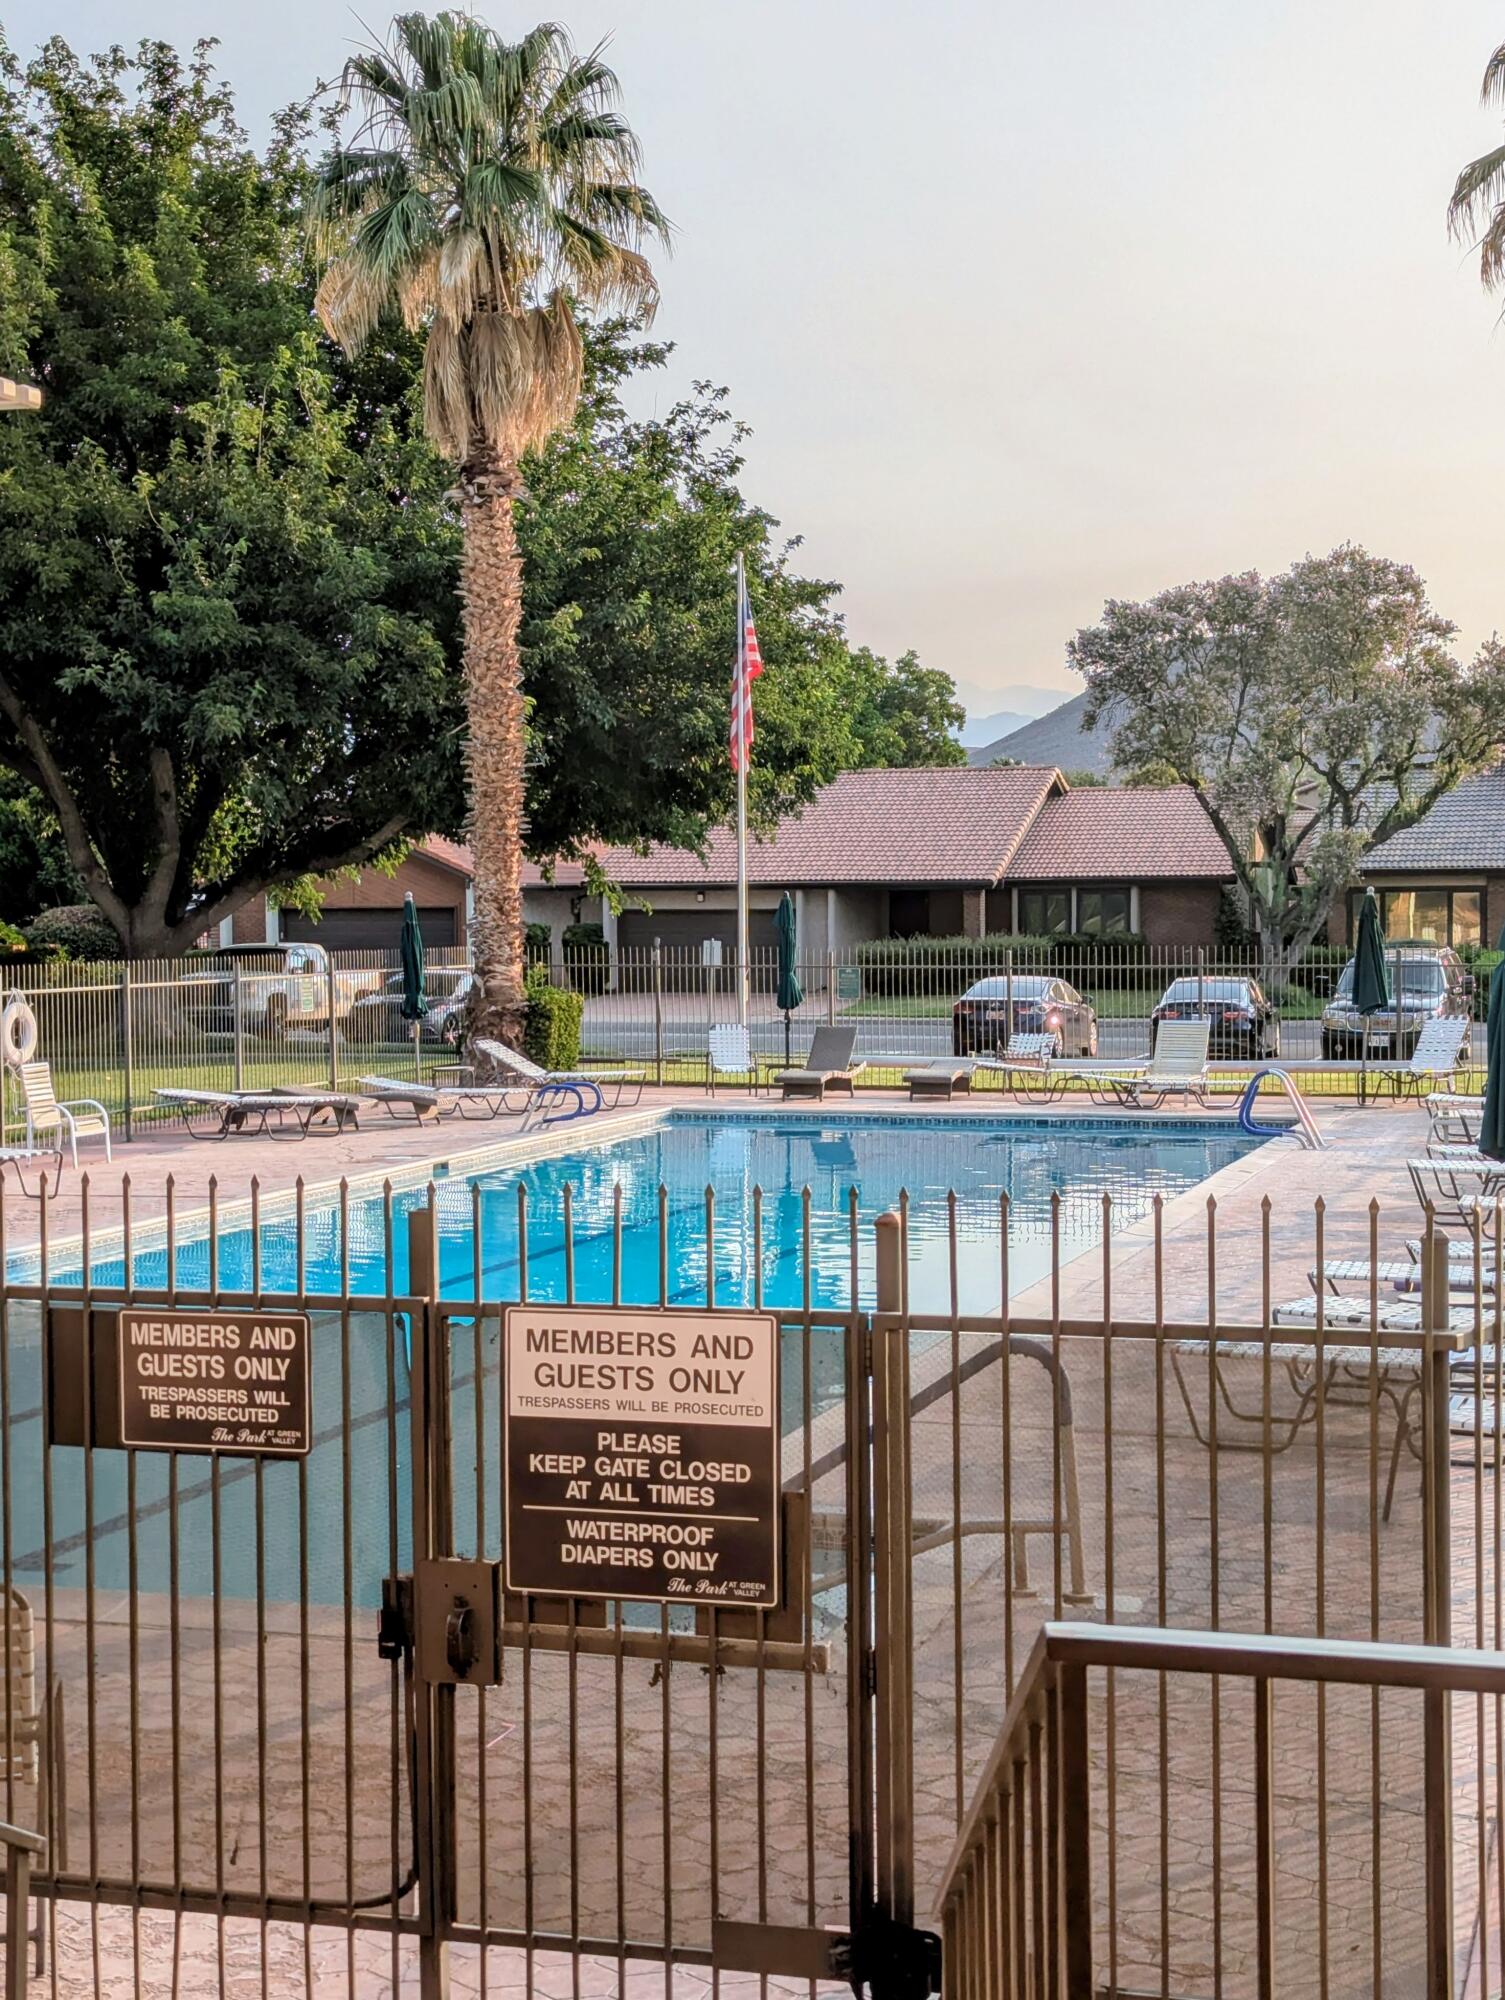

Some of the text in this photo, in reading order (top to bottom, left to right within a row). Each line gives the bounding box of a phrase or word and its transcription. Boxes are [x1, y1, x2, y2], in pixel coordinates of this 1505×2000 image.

[131, 1323, 296, 1350] MEMBERS AND
[527, 1329, 753, 1360] MEMBERS AND
[137, 1353, 290, 1380] GUESTS ONLY
[535, 1363, 745, 1394] GUESTS ONLY
[139, 1386, 290, 1405] TRESPASSERS WILL
[518, 1396, 763, 1417] TRESPASSERS WILL BE PROSECUTED
[150, 1405, 279, 1423] BE PROSECUTED
[211, 1428, 267, 1443] The Park
[598, 1433, 681, 1454] PLEASE
[529, 1454, 751, 1483] KEEP GATE CLOSED
[565, 1481, 715, 1506] AT ALL TIMES
[567, 1520, 714, 1546] WATERPROOF
[561, 1545, 719, 1571] DIAPERS ONLY
[667, 1578, 727, 1594] The Park
[740, 1582, 765, 1590] GREEN
